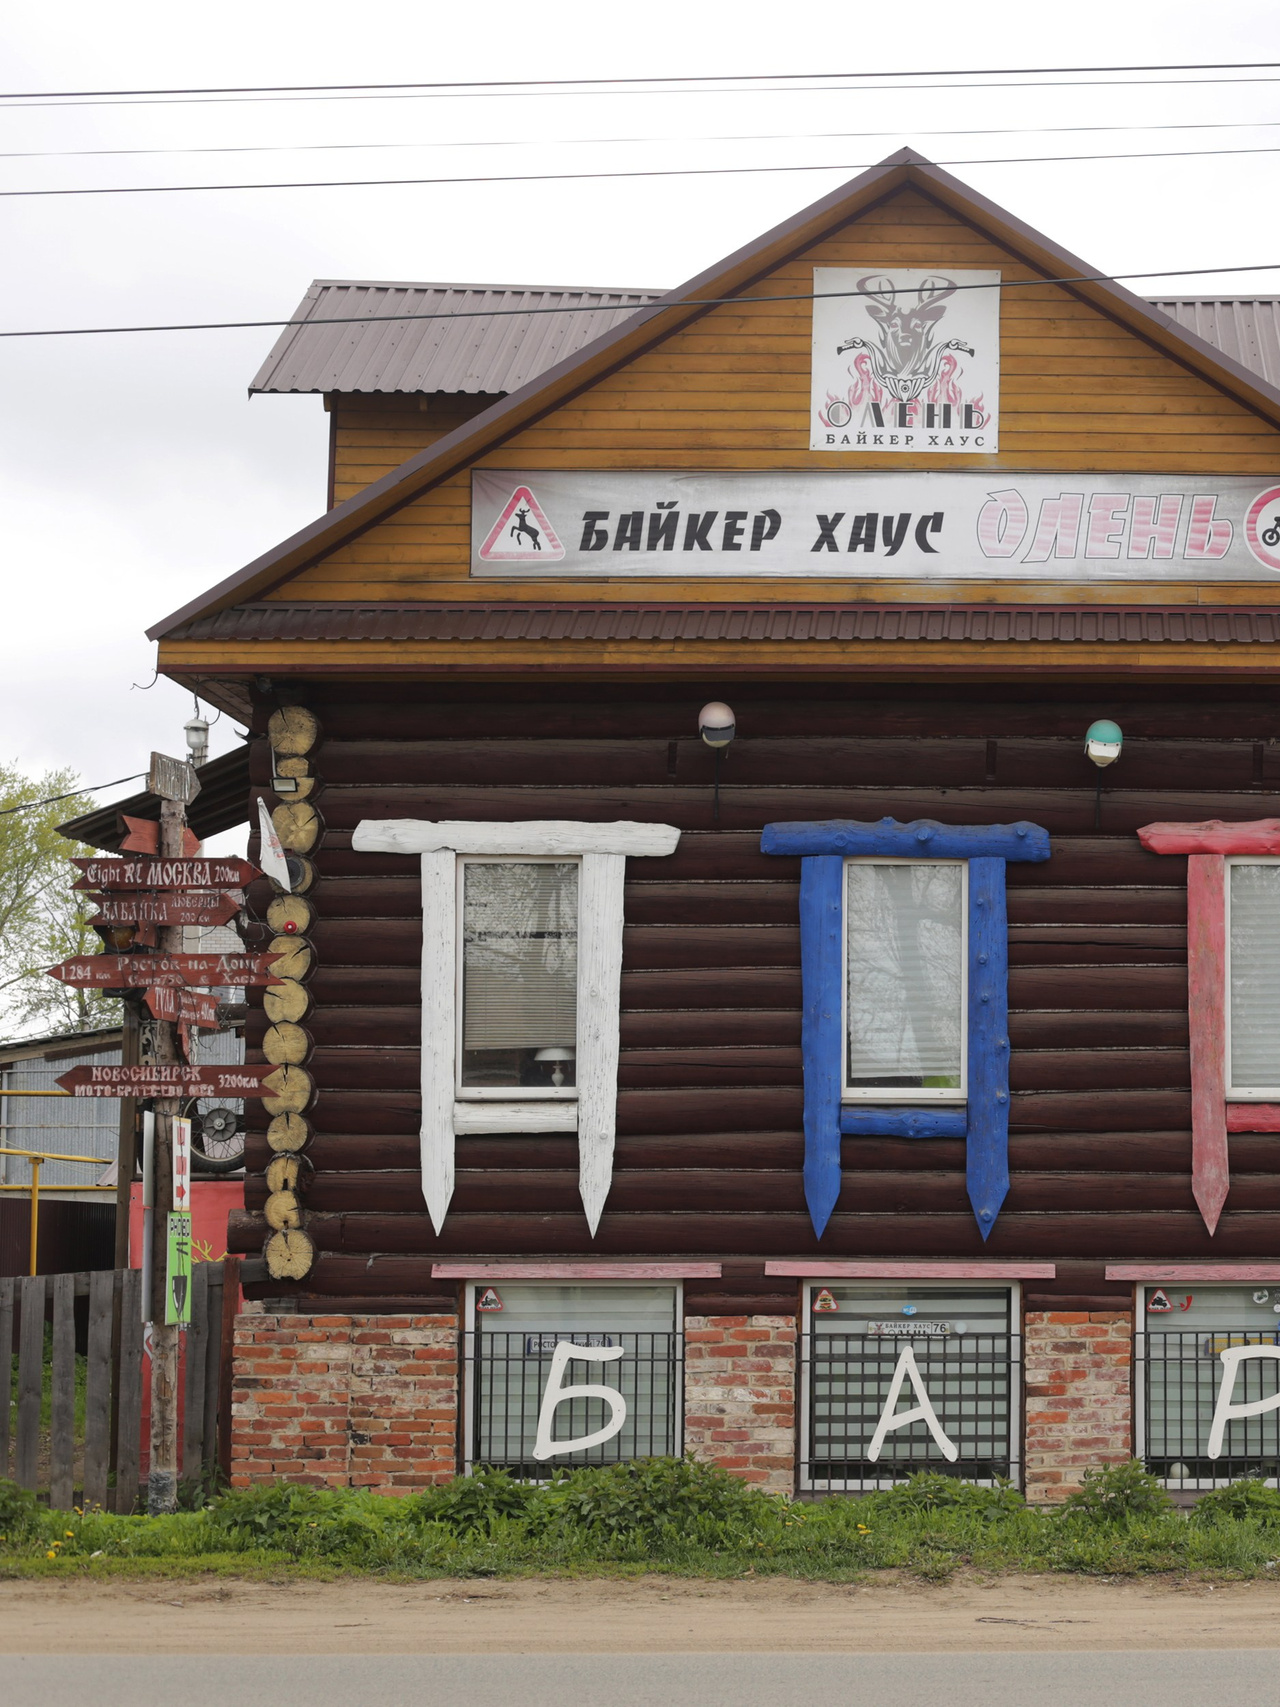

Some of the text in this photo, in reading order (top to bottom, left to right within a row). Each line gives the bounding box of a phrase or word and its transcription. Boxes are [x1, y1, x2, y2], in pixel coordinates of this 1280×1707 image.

[827, 401, 984, 429] ОЛЕНЬ
[825, 432, 985, 447] БАЙКЕР ХАУС
[579, 489, 1233, 563] БАЙКЕР ХАУС ОЛЕНЬ
[147, 862, 212, 885] МОСКВА
[102, 900, 168, 921] БАБАЙКА
[60, 965, 91, 980] 1.284
[91, 1066, 201, 1082] НОВОСИБИРСК
[218, 1074, 259, 1089] 3200км
[933, 1323, 946, 1333] 76
